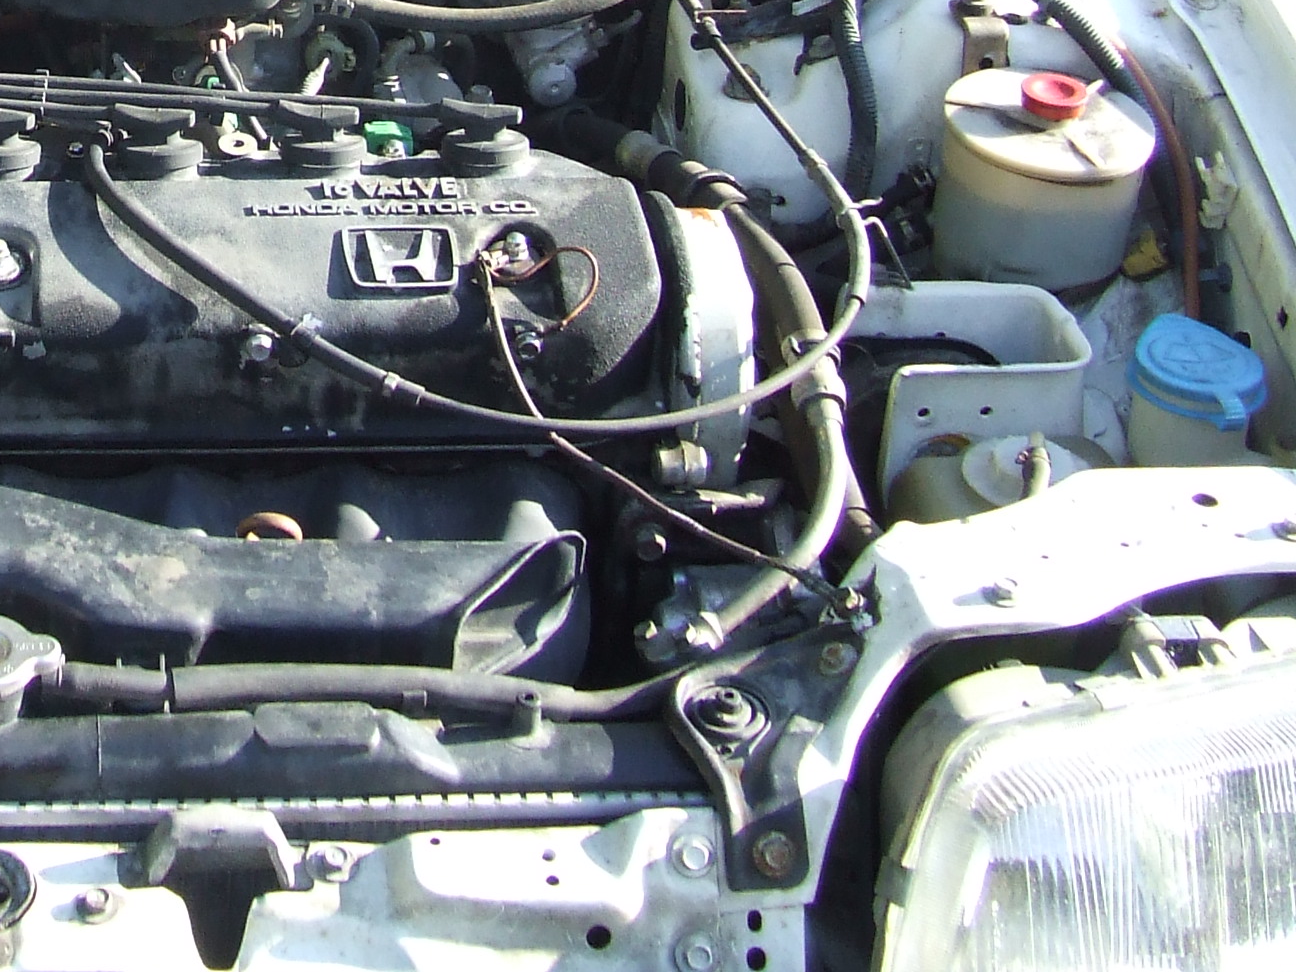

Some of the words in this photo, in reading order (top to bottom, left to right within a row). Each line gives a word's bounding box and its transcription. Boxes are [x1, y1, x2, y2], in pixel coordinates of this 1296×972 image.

[355, 177, 461, 200] VALVE
[252, 203, 360, 217] HONDA
[371, 201, 479, 216] MOTOR
